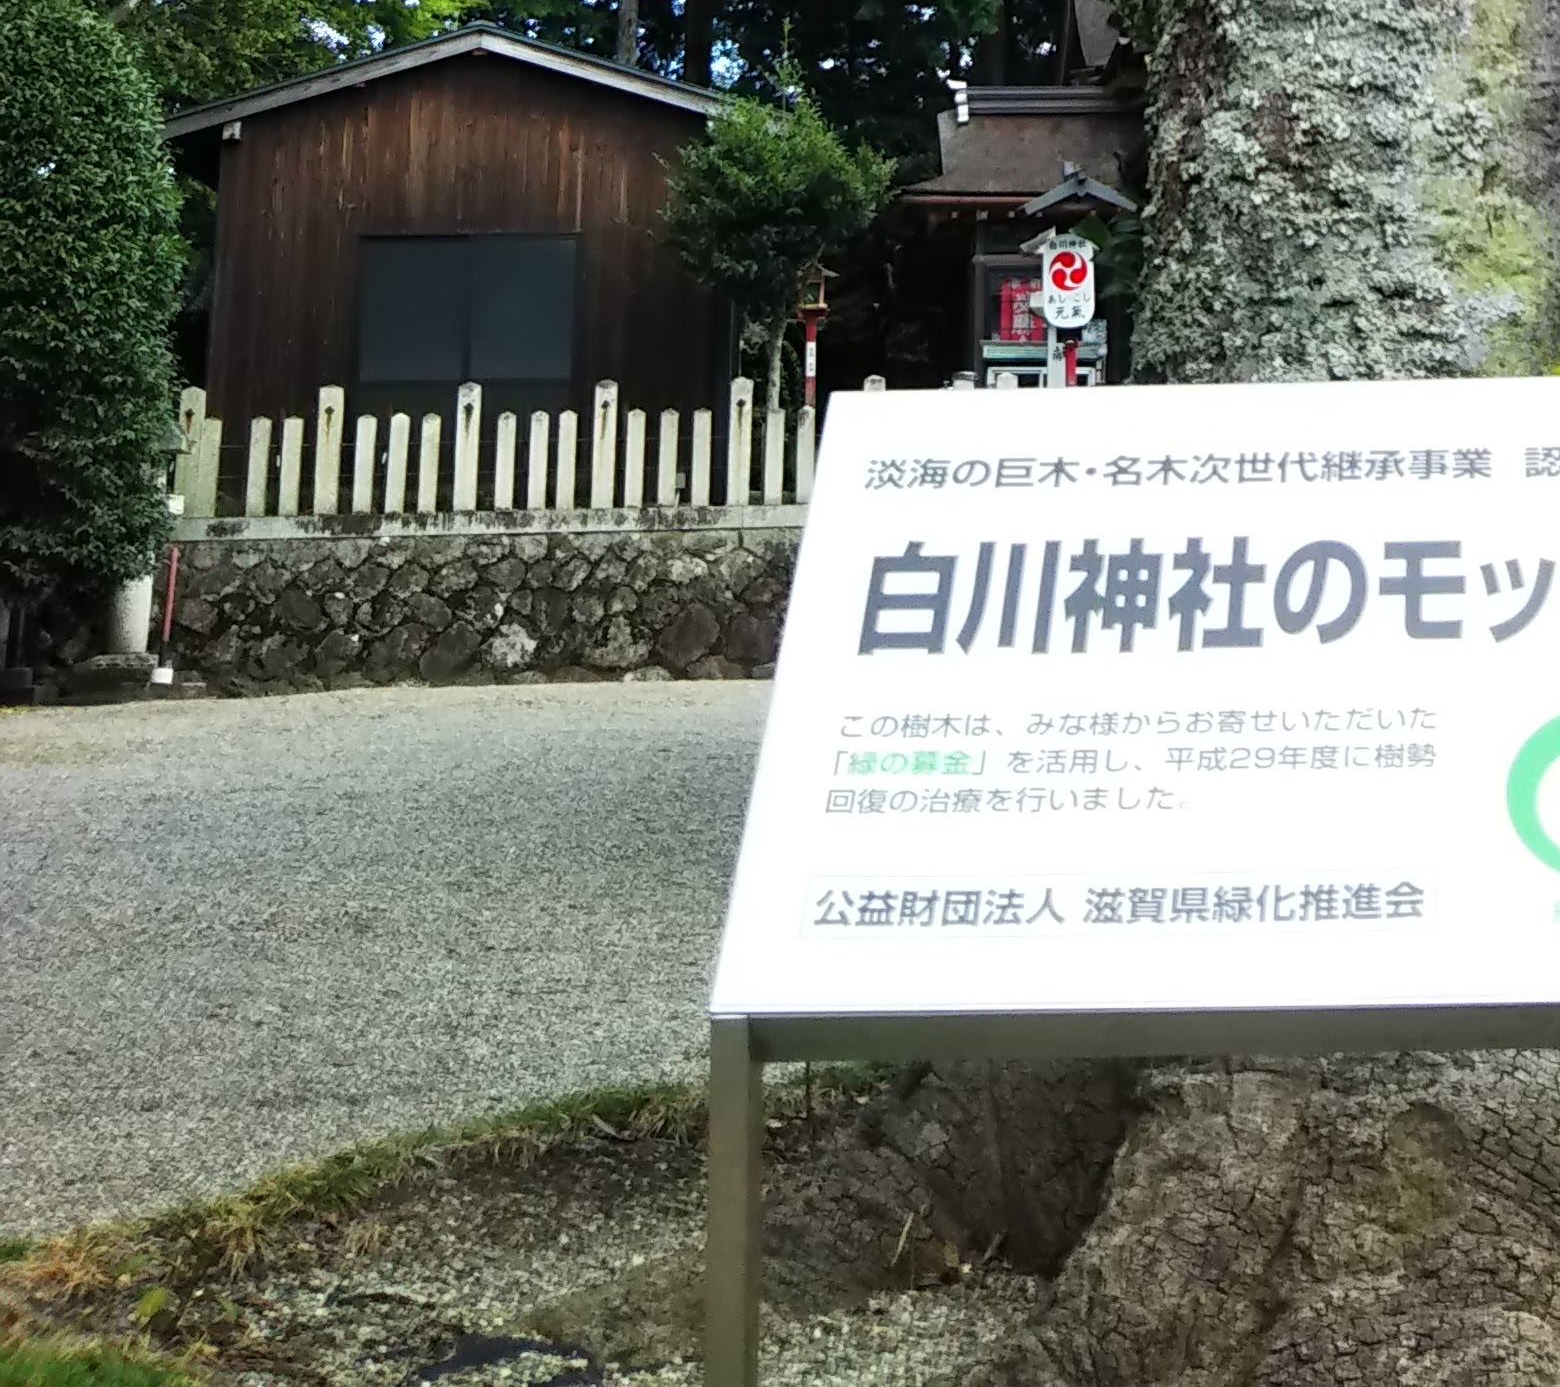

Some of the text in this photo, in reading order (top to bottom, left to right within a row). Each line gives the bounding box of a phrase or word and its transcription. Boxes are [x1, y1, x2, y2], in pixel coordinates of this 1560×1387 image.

[864, 448, 1493, 489] 淡海の巨木・名木次世代継承事業
[840, 707, 1437, 738] この樹木は、みな様からお寄せいただいた
[825, 787, 1188, 815] 回復の治療を行いました。
[813, 881, 1425, 927] 公益財団法人 滋賀県緑化推進会
